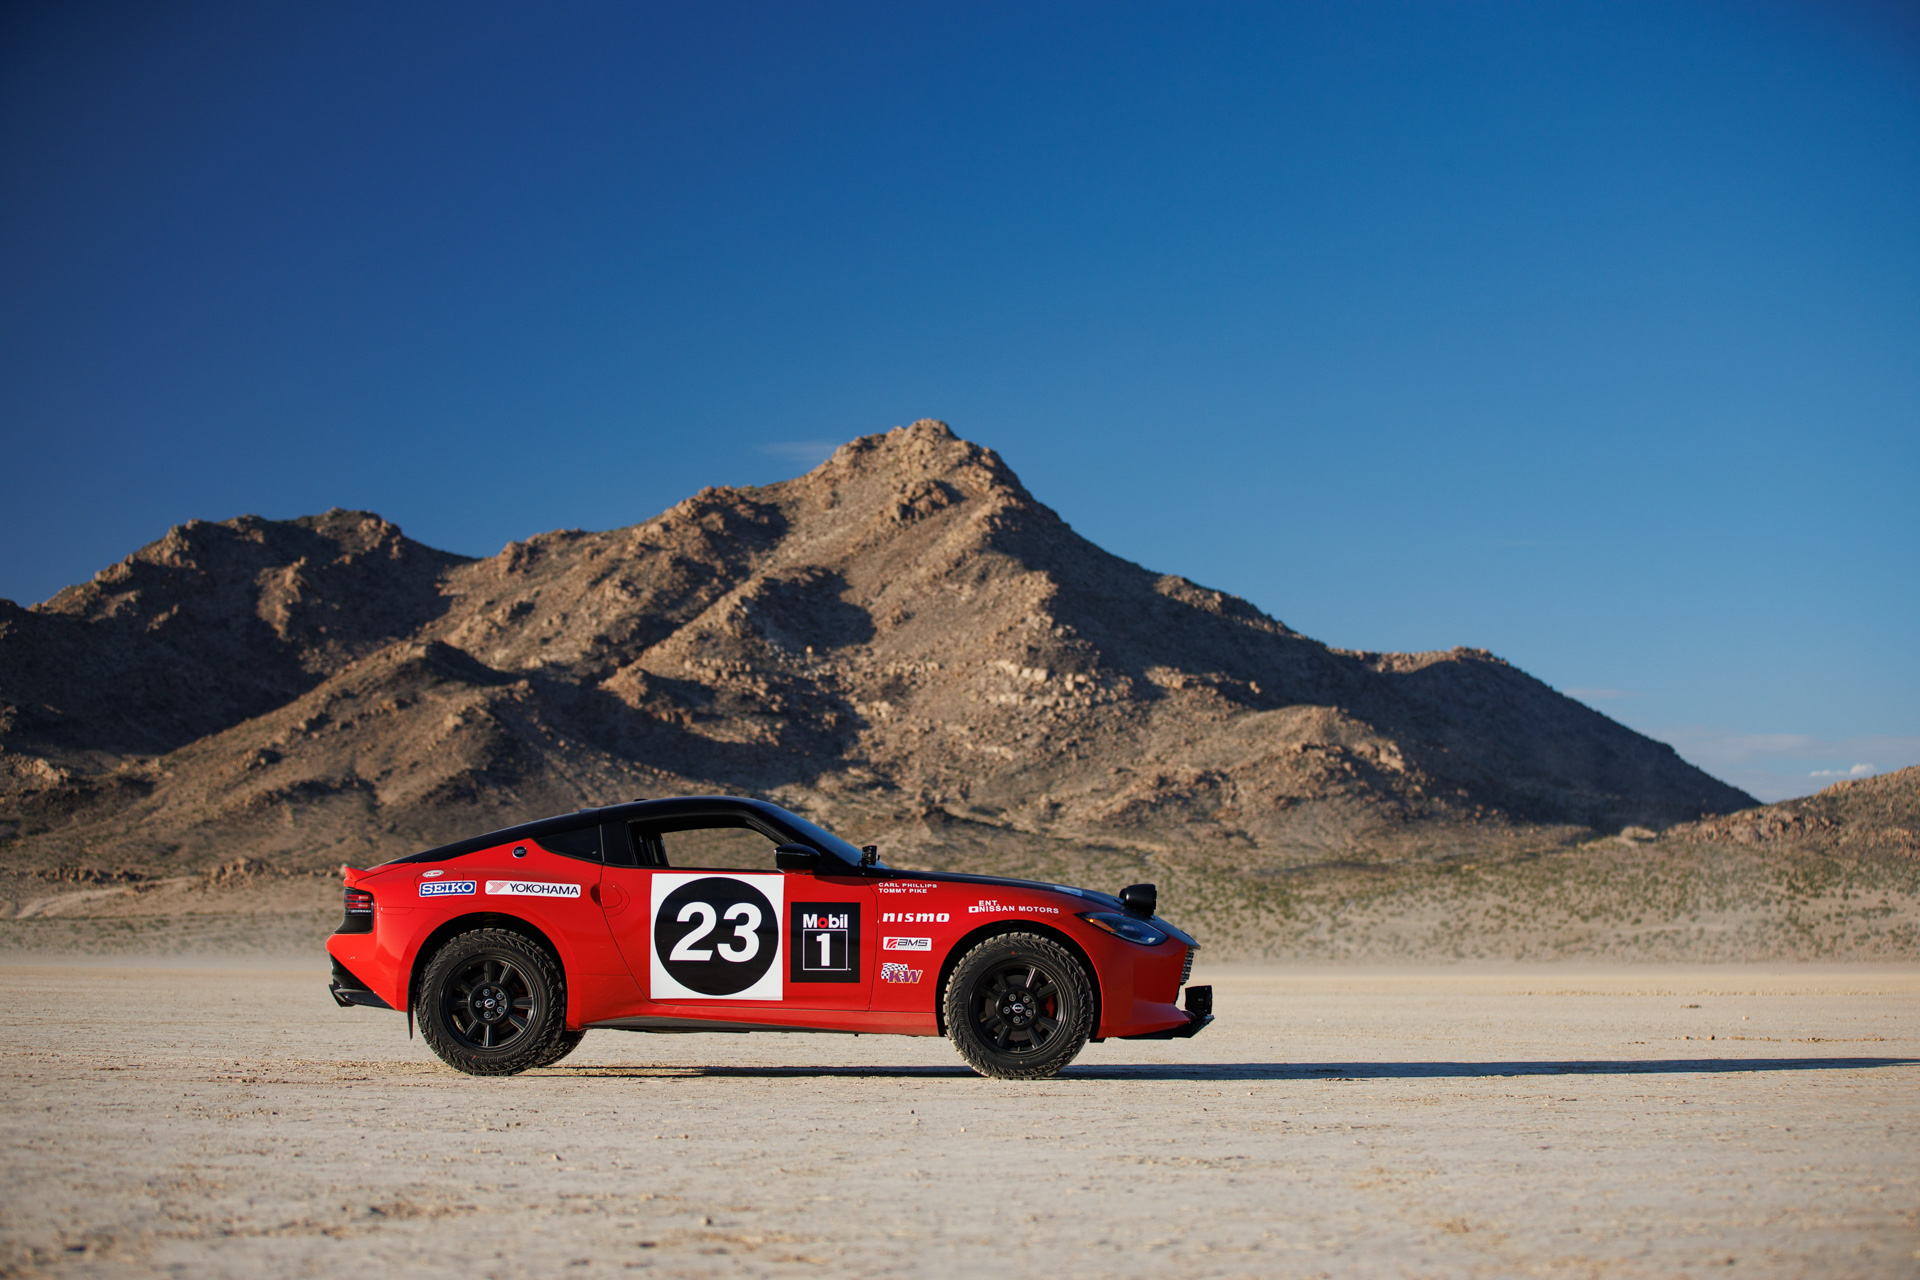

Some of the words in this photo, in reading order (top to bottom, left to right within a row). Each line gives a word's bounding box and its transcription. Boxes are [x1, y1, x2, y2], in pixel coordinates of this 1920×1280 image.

[421, 882, 474, 895] SEIKO
[509, 883, 579, 896] YOKOHAMA
[1018, 906, 1060, 914] MOTORS
[802, 913, 848, 929] Mobil
[882, 912, 950, 923] nismo
[669, 901, 762, 963] 23
[816, 933, 830, 966] 1
[887, 969, 924, 984] KW
